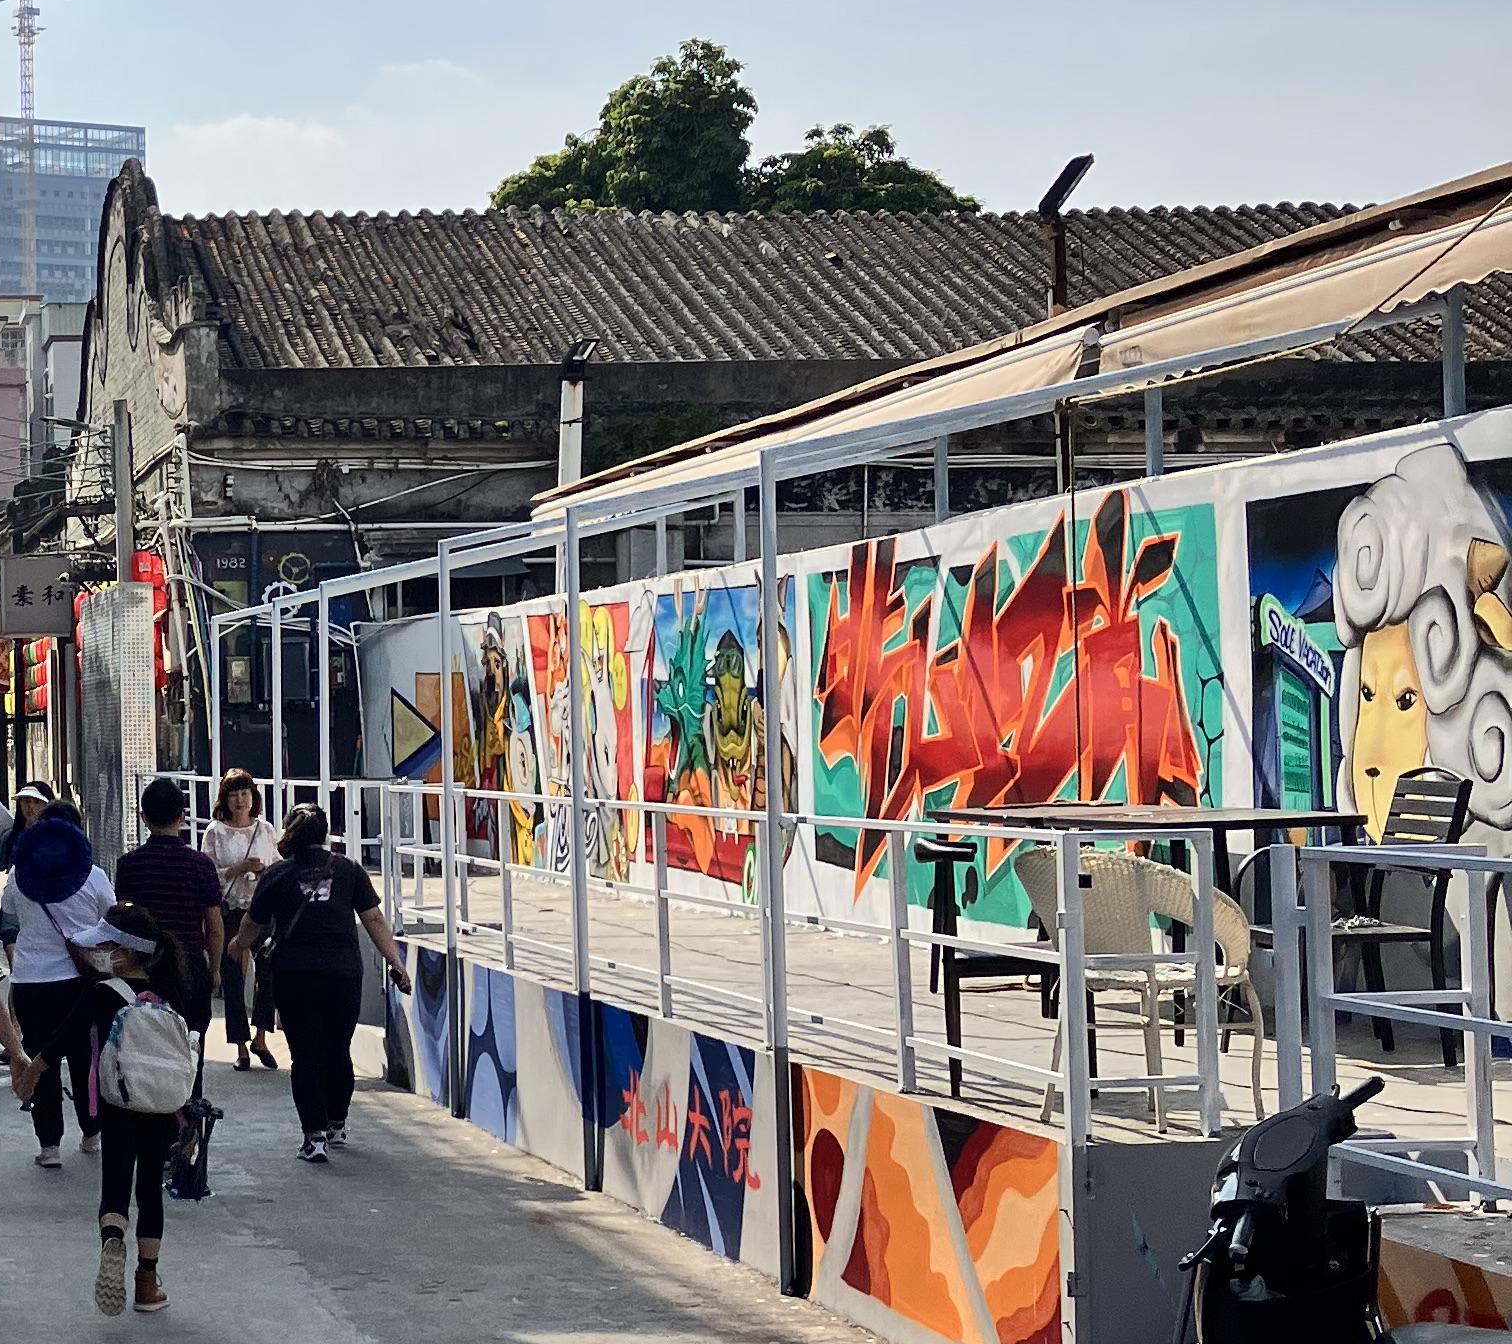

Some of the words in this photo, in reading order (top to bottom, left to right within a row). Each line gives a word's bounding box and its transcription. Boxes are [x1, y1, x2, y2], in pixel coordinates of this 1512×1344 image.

[216, 557, 247, 569] 1982
[619, 1064, 761, 1190] 北山大院
